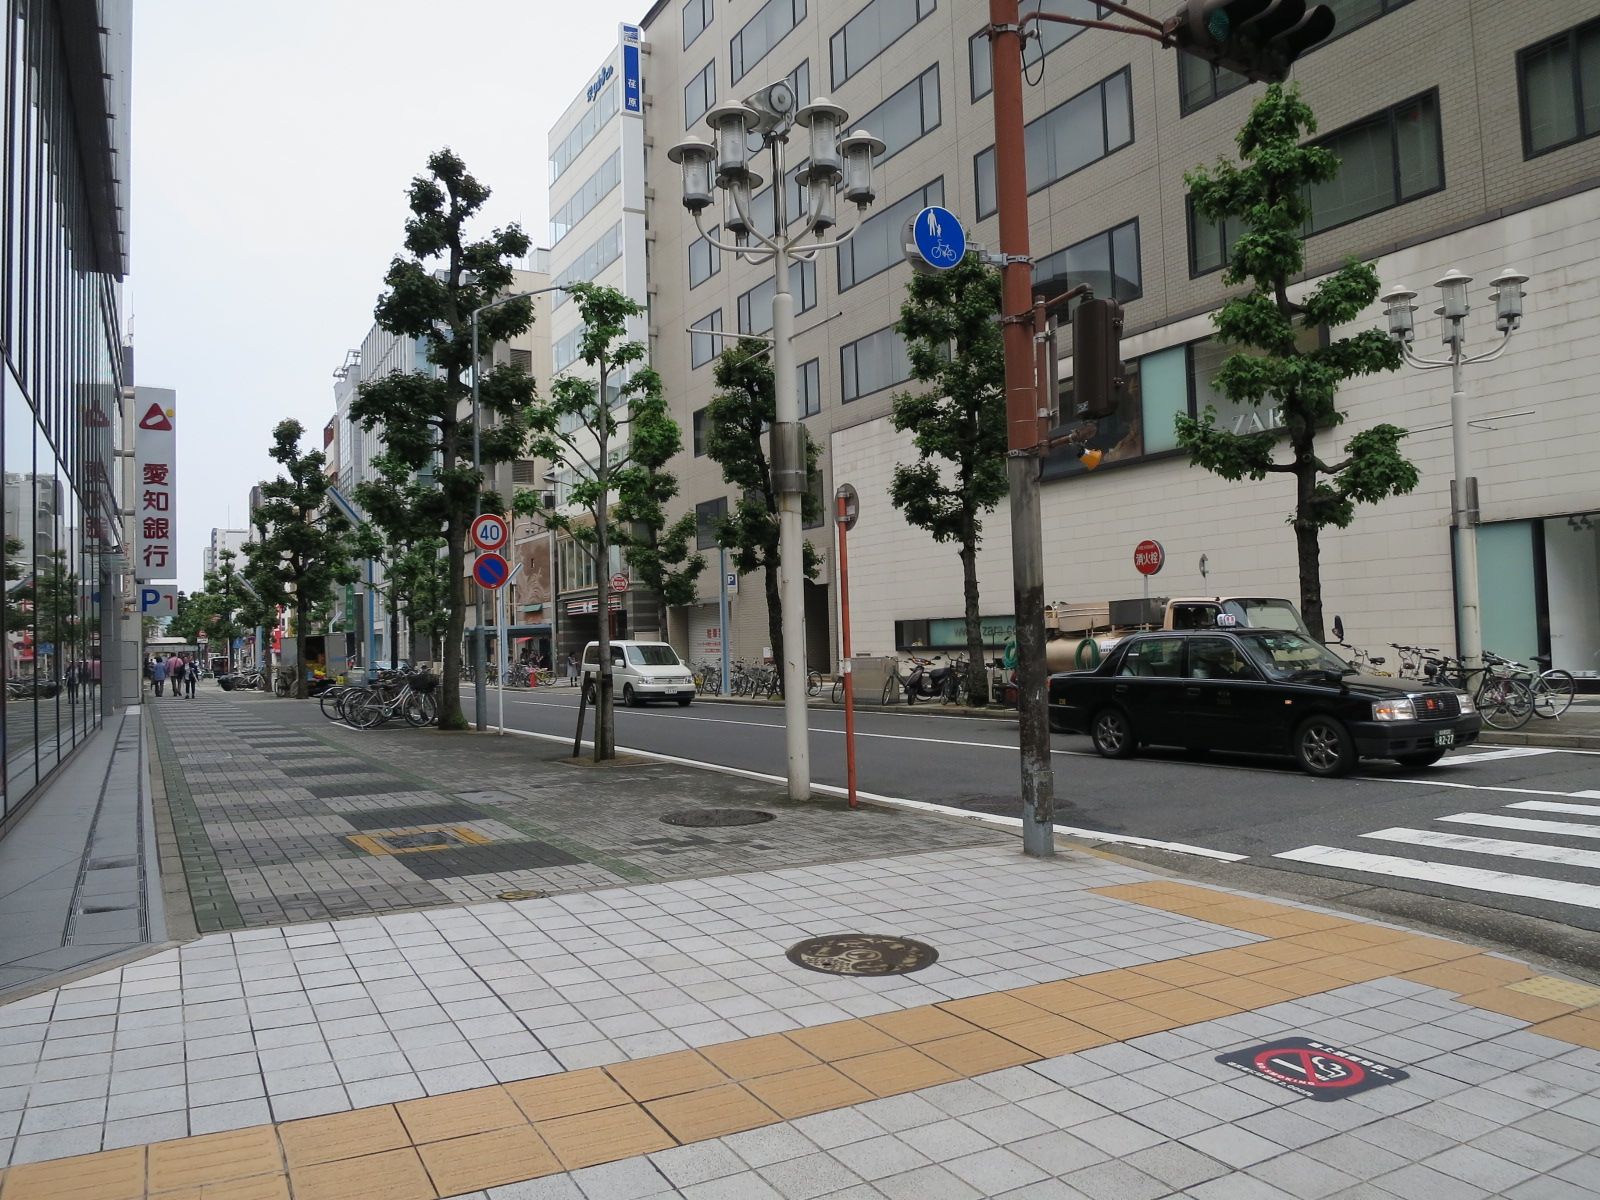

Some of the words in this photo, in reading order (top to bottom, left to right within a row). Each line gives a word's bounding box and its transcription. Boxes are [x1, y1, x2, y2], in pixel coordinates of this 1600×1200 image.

[1232, 407, 1286, 436] ZAR
[143, 463, 169, 568] 愛知銀行
[480, 525, 499, 541] 40
[1135, 552, 1158, 565] 消火栓
[728, 576, 734, 584] P
[142, 589, 160, 612] P
[1264, 1069, 1315, 1086] SMOKING
